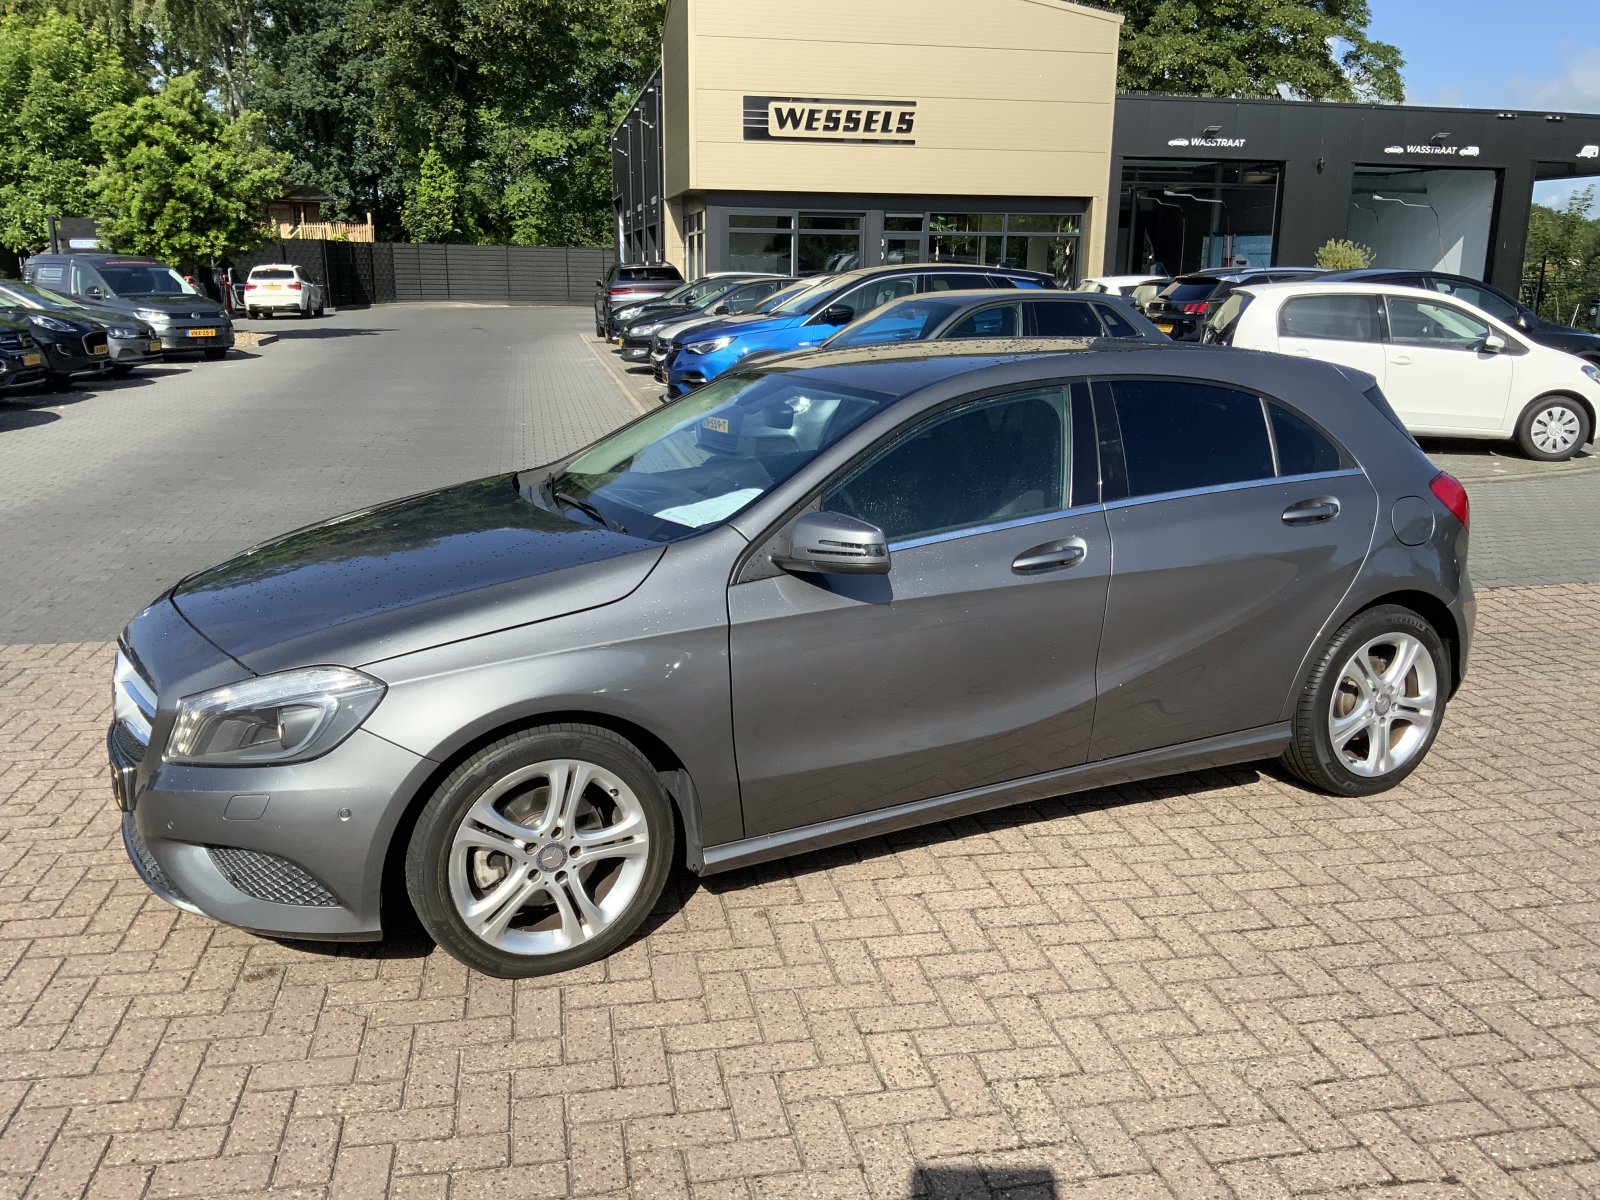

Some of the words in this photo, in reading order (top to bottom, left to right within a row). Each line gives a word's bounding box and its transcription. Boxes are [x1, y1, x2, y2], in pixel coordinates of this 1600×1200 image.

[774, 107, 916, 135] WESSELS
[1190, 138, 1246, 148] WASSTRAAT
[1406, 145, 1458, 155] WASSTRAAT
